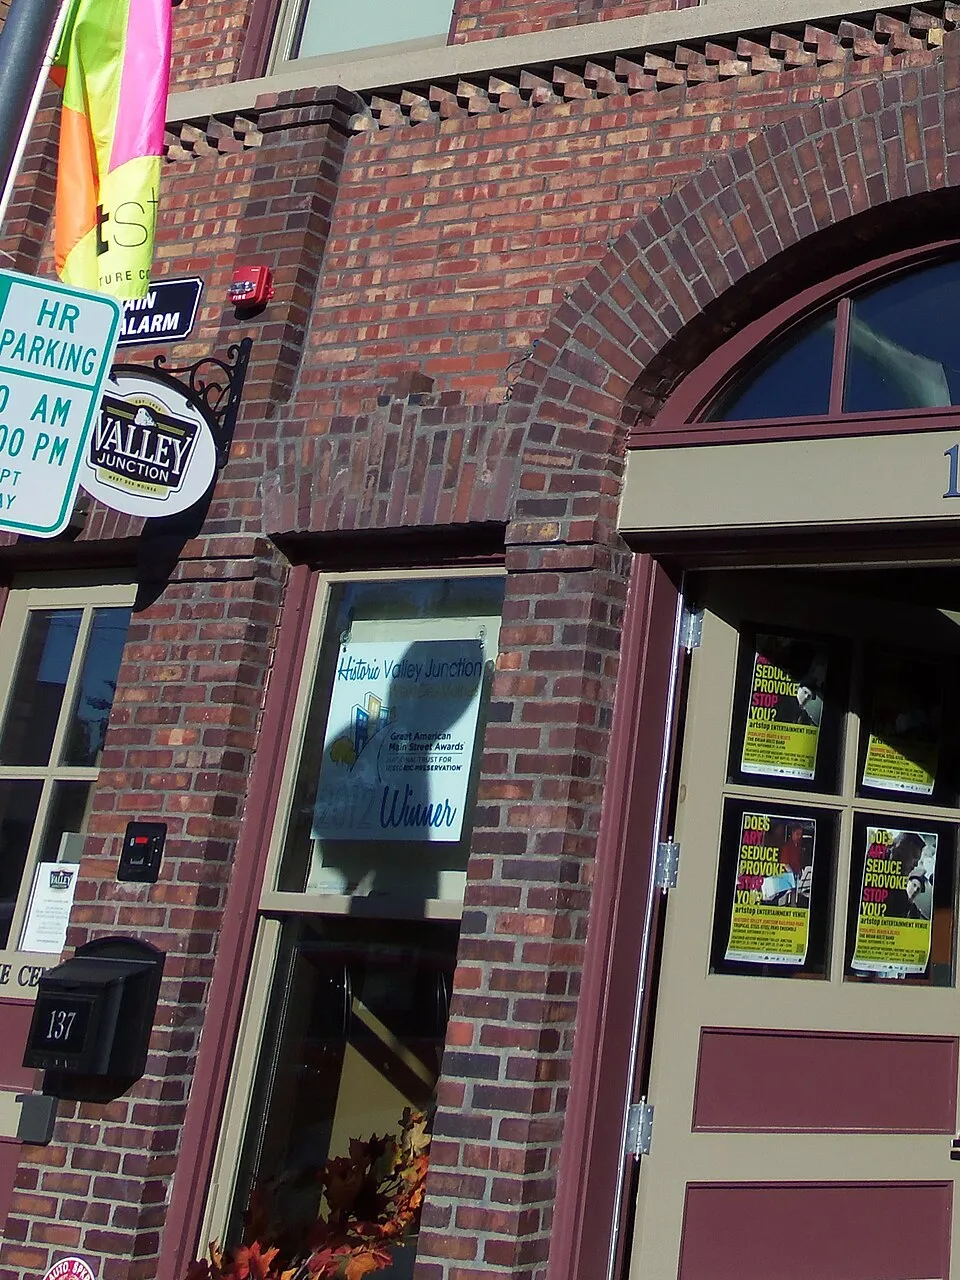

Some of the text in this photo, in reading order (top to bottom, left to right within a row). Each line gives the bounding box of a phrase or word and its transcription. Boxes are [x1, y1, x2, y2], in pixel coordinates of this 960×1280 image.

[36, 299, 80, 334] HR
[0, 328, 97, 376] PARKING
[30, 394, 72, 427] AM
[32, 432, 69, 467] PM
[96, 410, 192, 475] VALLEY
[96, 452, 169, 483] JUNCTION
[338, 657, 483, 681] Historic Valley Junction
[754, 678, 800, 697] PROVOKE
[752, 692, 778, 707] STOP
[751, 706, 777, 721] YOU?
[390, 732, 451, 741] Great American
[389, 742, 464, 751] Main Street Awards
[380, 784, 458, 828] Winner
[744, 814, 770, 832] DOES
[742, 831, 764, 845] ART
[869, 829, 894, 845] DOES
[741, 845, 778, 863] SEDUCE
[867, 844, 887, 858] ART
[739, 861, 786, 876] PROVOKE
[866, 859, 901, 875] SEDUCE
[864, 873, 907, 890] PROVOKE
[736, 890, 762, 906] YOU?
[863, 888, 888, 902] STOP
[735, 907, 755, 916] artstop
[861, 902, 887, 917] YOU?
[46, 1010, 76, 1040] 137
[49, 1262, 69, 1280] AUTO
